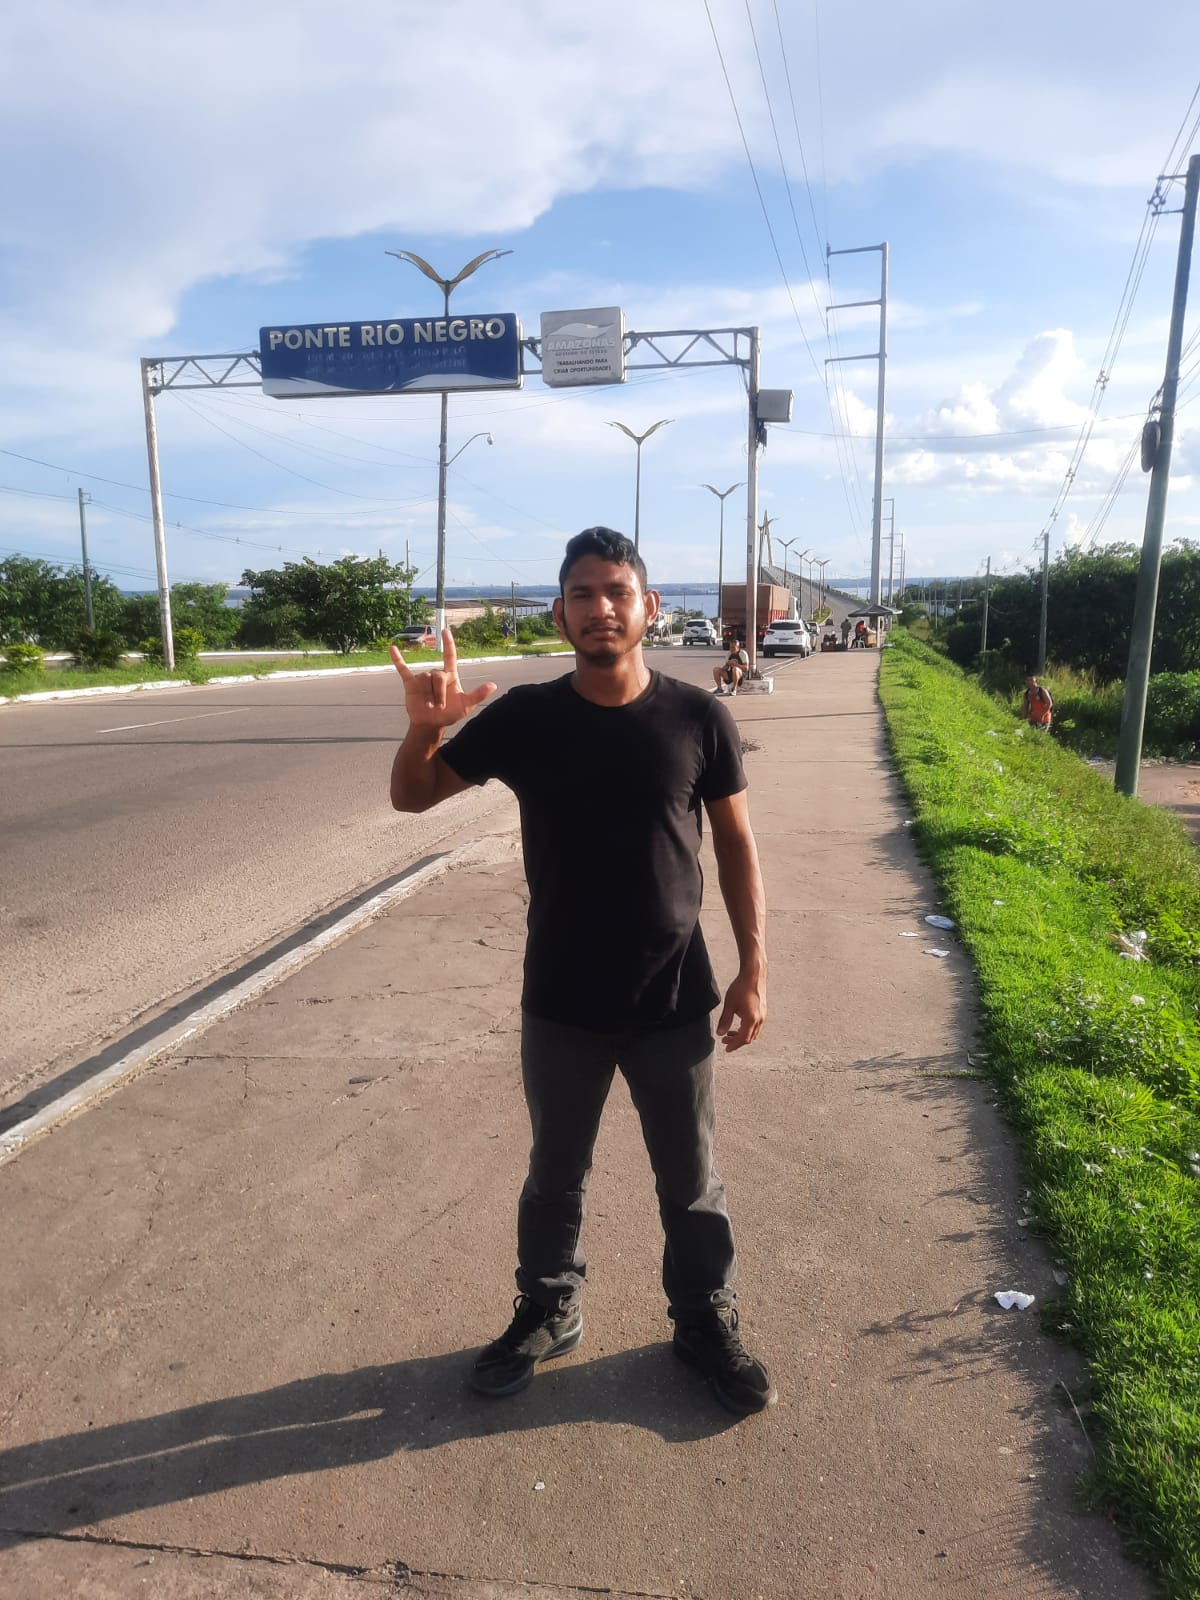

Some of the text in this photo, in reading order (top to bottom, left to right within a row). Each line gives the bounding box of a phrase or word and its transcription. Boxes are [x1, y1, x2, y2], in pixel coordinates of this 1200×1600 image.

[269, 318, 506, 350] PONTE RIO NEGRO
